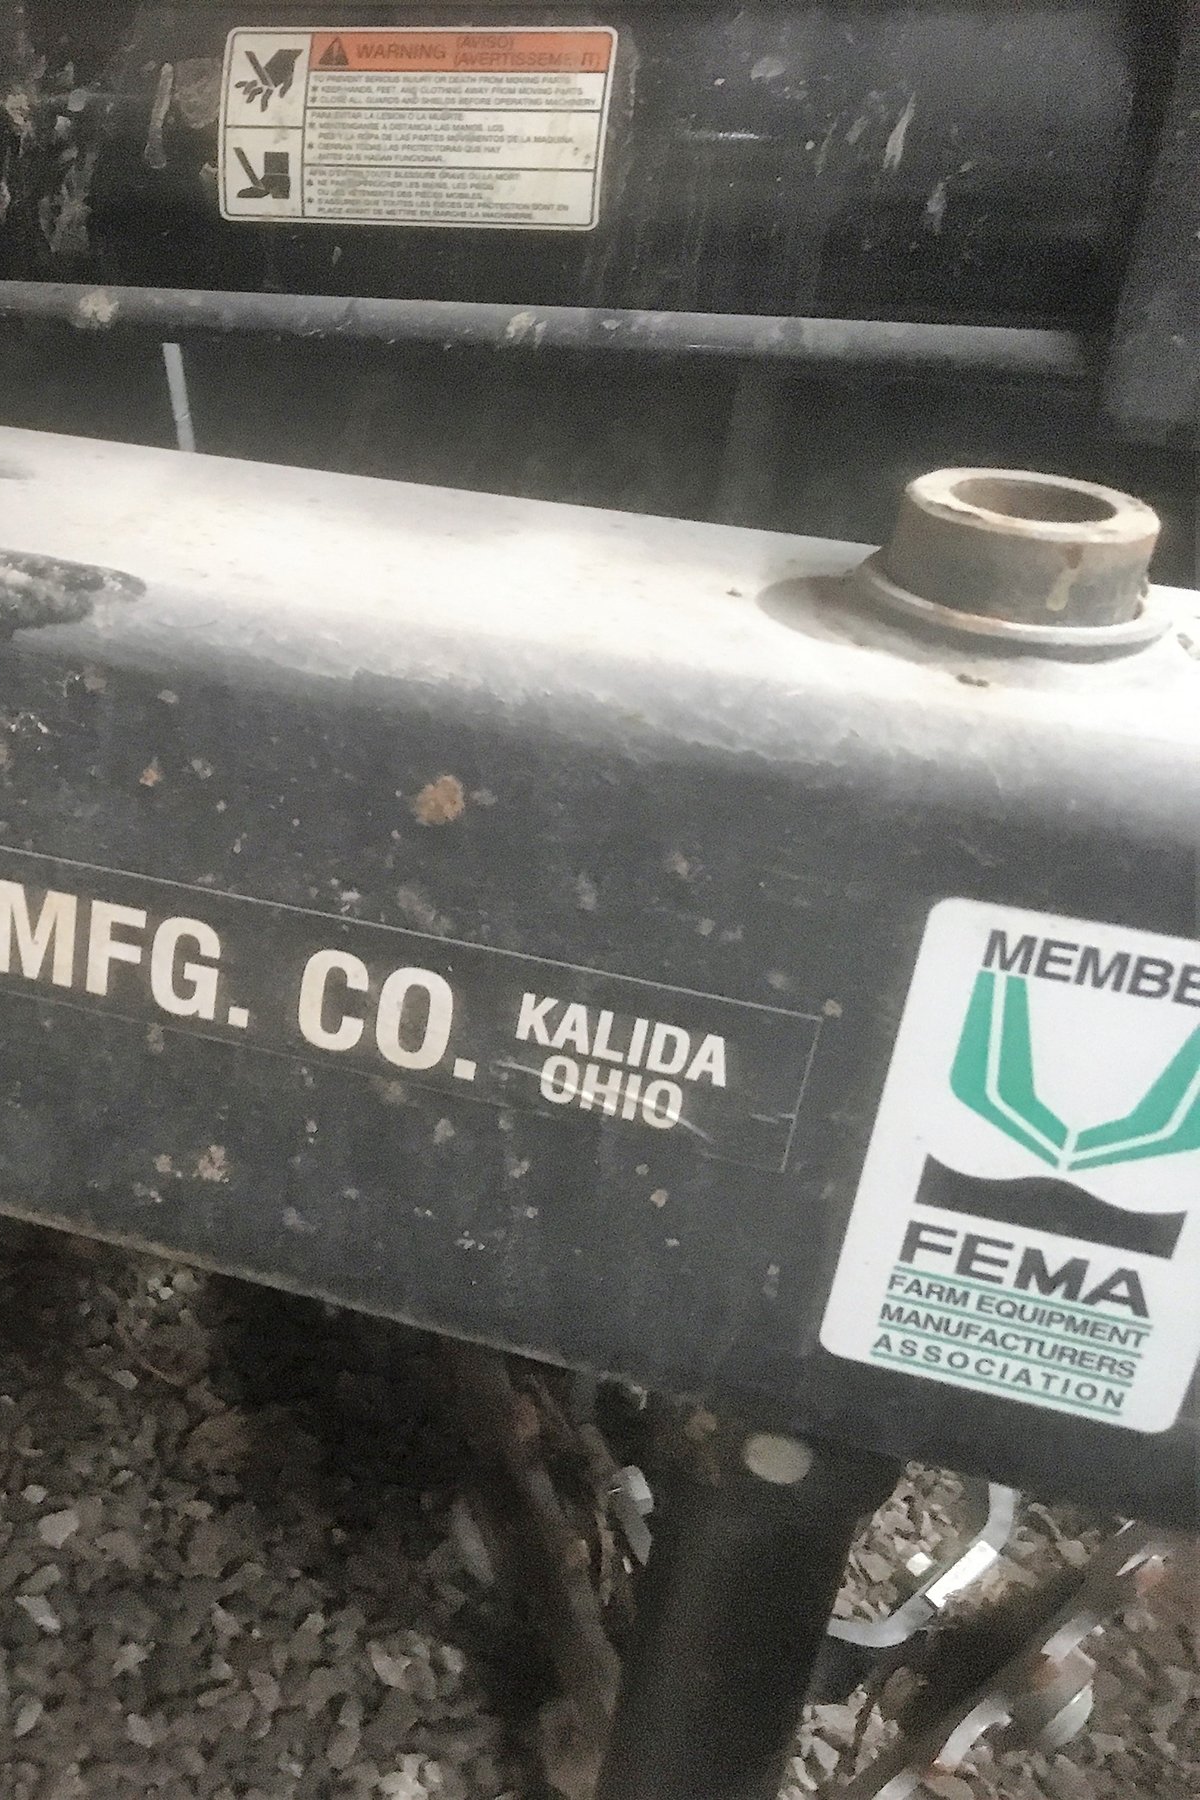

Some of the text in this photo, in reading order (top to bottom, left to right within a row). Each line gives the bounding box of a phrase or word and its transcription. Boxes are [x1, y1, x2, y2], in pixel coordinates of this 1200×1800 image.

[355, 43, 447, 60] WARNING
[453, 51, 600, 68] (AVERTISSEMET)
[297, 949, 477, 1081] CO.
[515, 992, 727, 1088] KALIDA
[540, 1055, 683, 1129] OHIO
[899, 1220, 1150, 1318] FEMA
[880, 1303, 1137, 1379] MANUFACTURERS
[887, 1274, 1151, 1349] FARM EQUIPMENT
[873, 1333, 1125, 1408] ASSOCIATION
